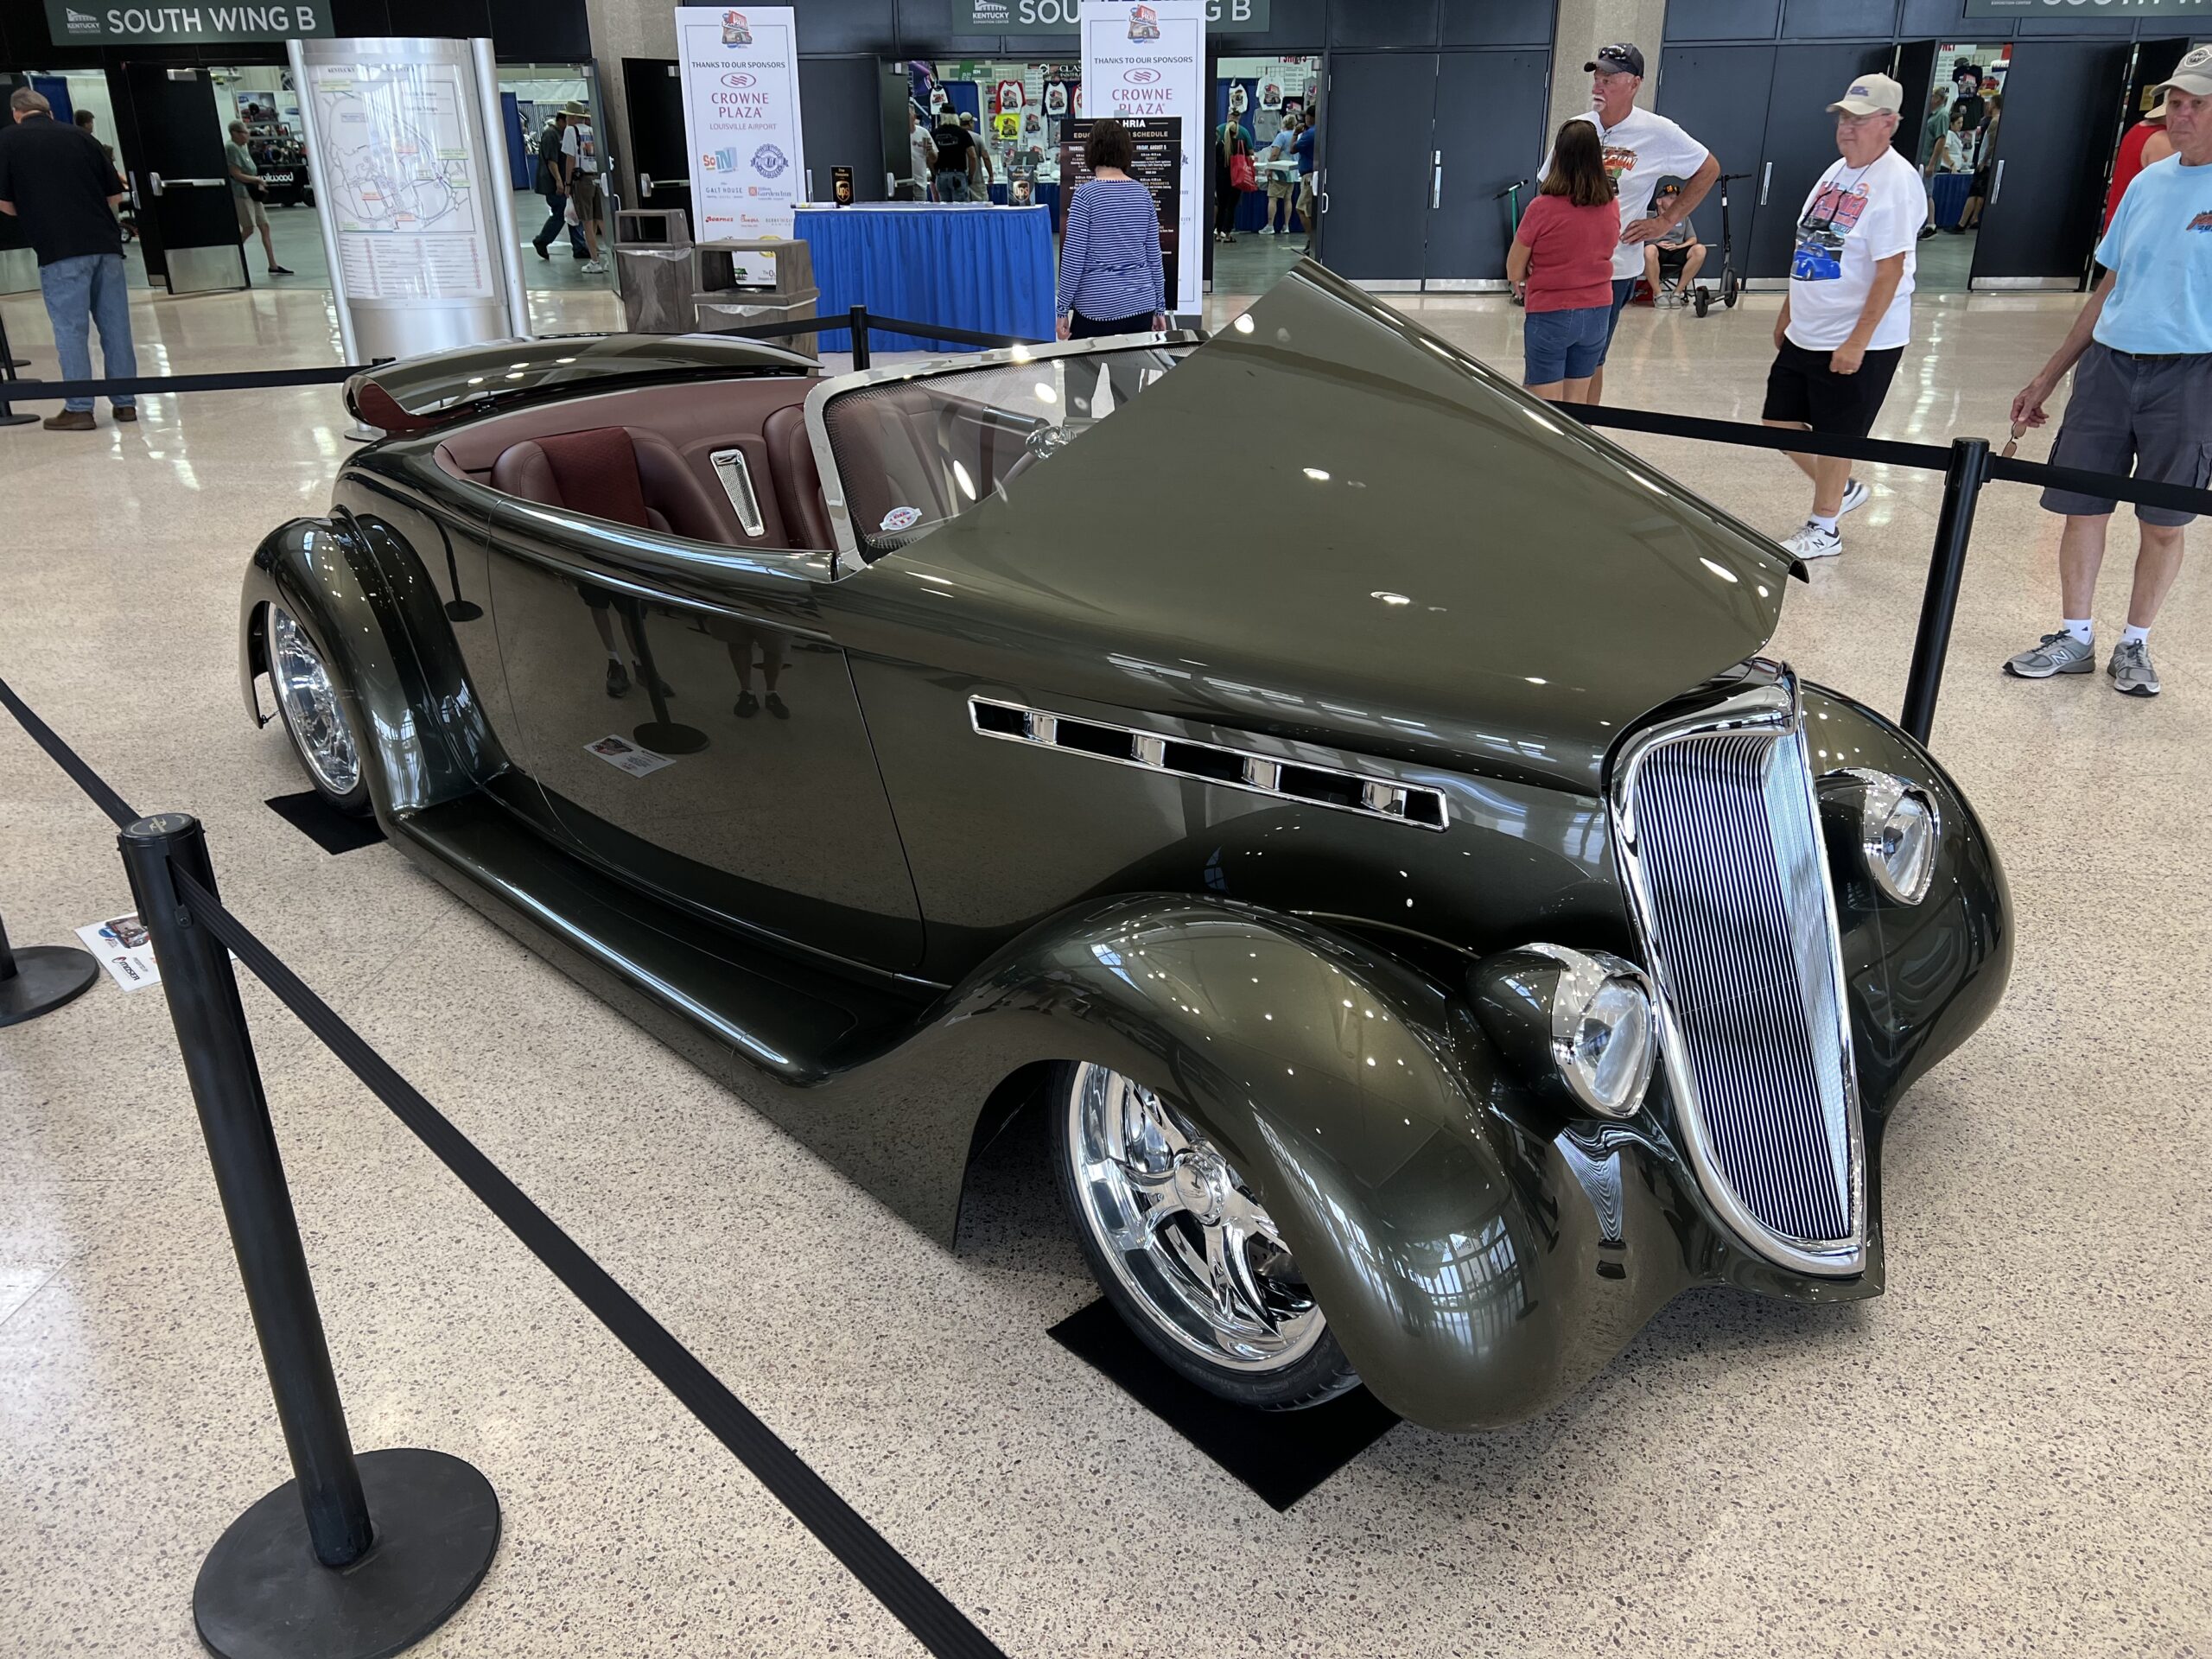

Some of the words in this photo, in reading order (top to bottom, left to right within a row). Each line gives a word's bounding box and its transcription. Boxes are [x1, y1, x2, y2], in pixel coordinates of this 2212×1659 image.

[1232, 0, 1251, 21] B
[107, 8, 202, 34] SOUTH
[208, 6, 289, 32] WING
[296, 6, 316, 30] B
[711, 92, 769, 104] CROWNE
[1112, 88, 1173, 100] CROWNE
[719, 106, 762, 118] PLAZA
[1119, 104, 1164, 115] PLAZA
[1122, 119, 1146, 128] HRIA
[839, 187, 849, 199] ups
[1014, 187, 1028, 199] ups
